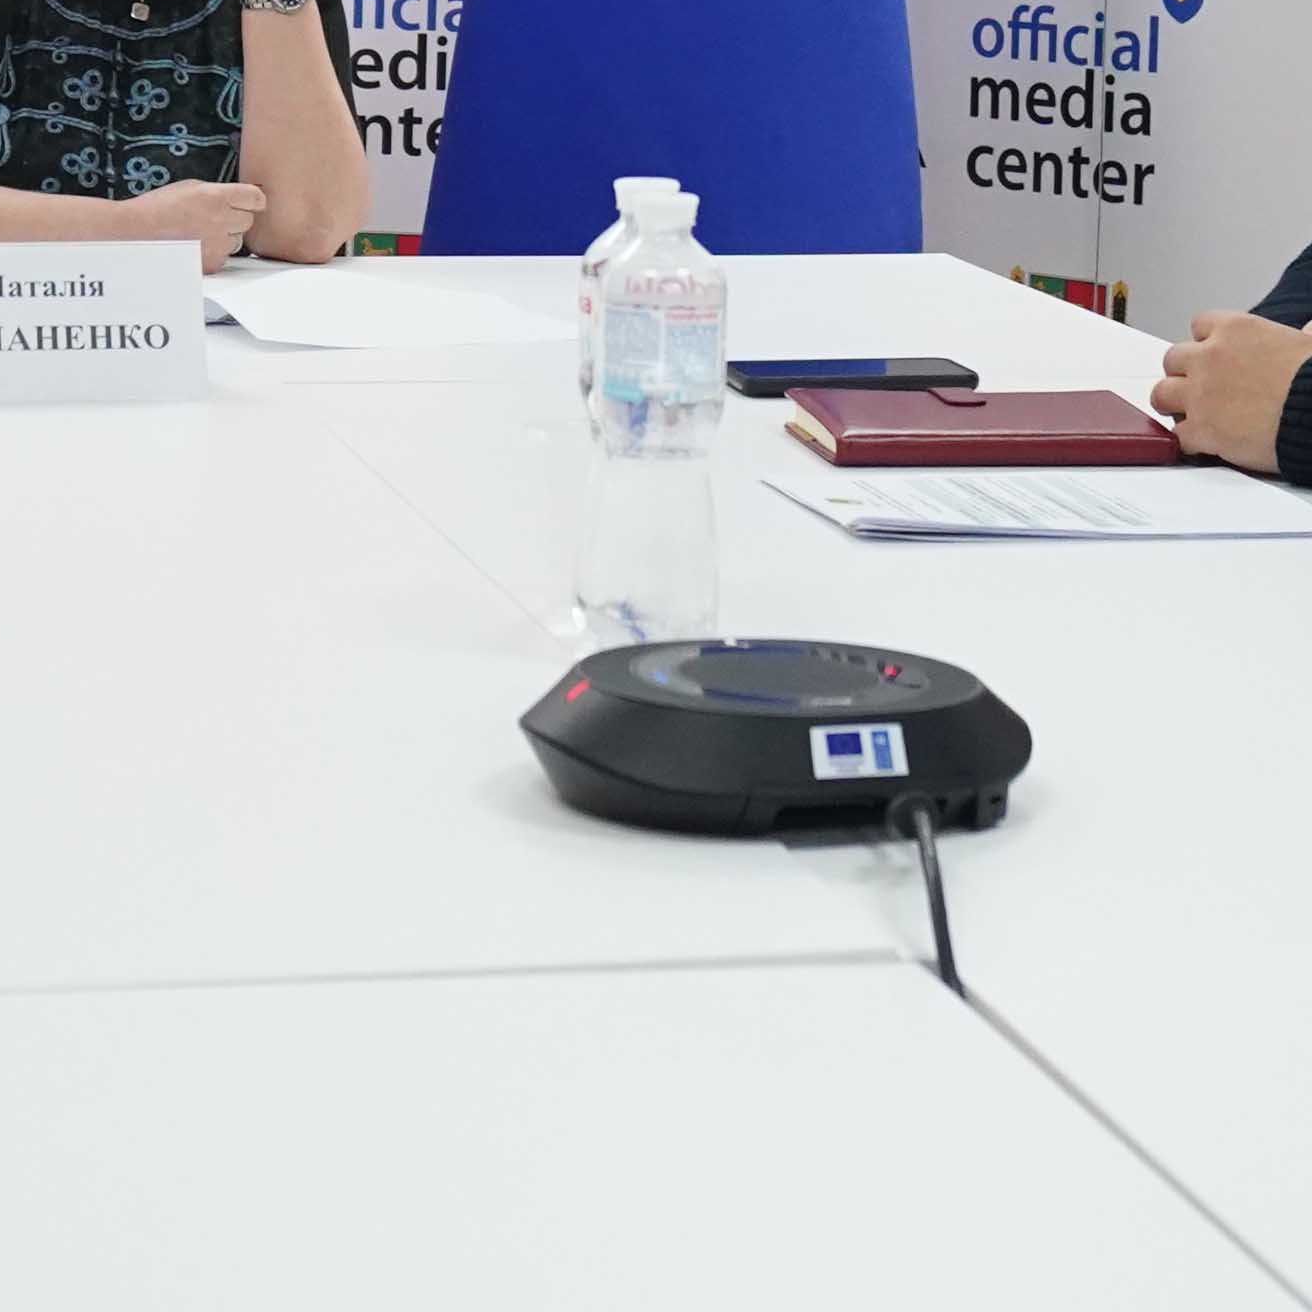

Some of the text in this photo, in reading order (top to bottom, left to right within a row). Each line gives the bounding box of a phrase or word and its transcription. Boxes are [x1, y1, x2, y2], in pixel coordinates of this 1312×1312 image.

[351, 33, 448, 90] edi
[972, 4, 1159, 74] official
[969, 69, 1153, 137] media
[966, 145, 1155, 206] center
